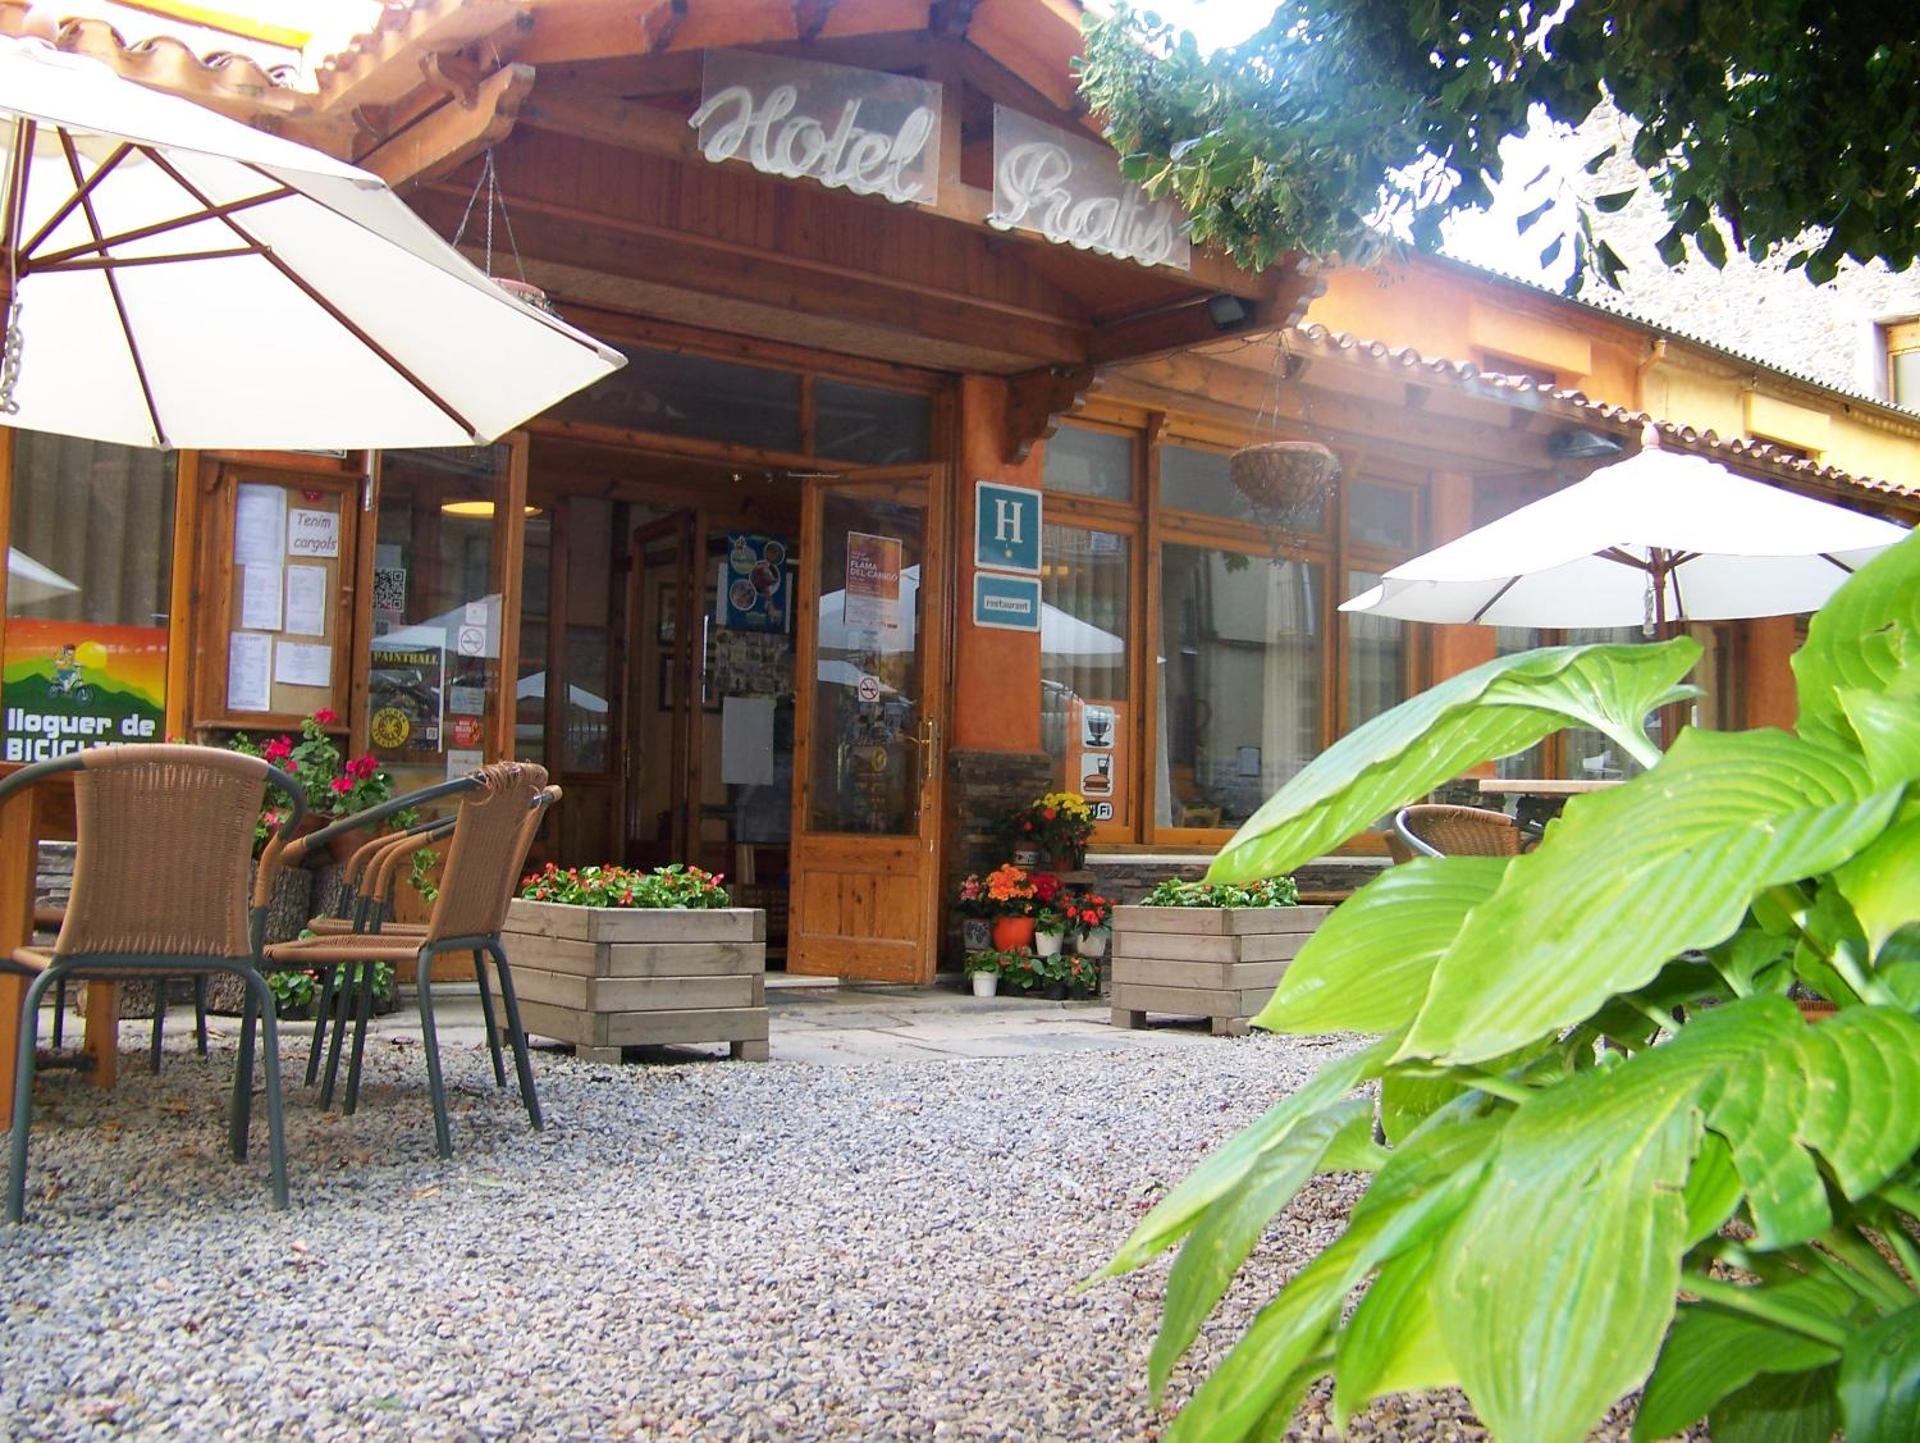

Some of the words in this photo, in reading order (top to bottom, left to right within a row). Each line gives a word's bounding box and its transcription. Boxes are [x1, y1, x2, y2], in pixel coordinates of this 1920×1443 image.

[688, 86, 934, 204] Hotel
[987, 142, 1173, 266] Prats
[297, 512, 332, 528] Tenim
[994, 498, 1023, 544] H
[294, 536, 337, 553] cargols
[850, 560, 877, 569] FLAMA
[850, 568, 866, 577] DEL
[986, 599, 1028, 611] restaurant
[374, 652, 439, 666] PAINTBALL
[8, 707, 112, 738] lloguer
[121, 713, 155, 737] de
